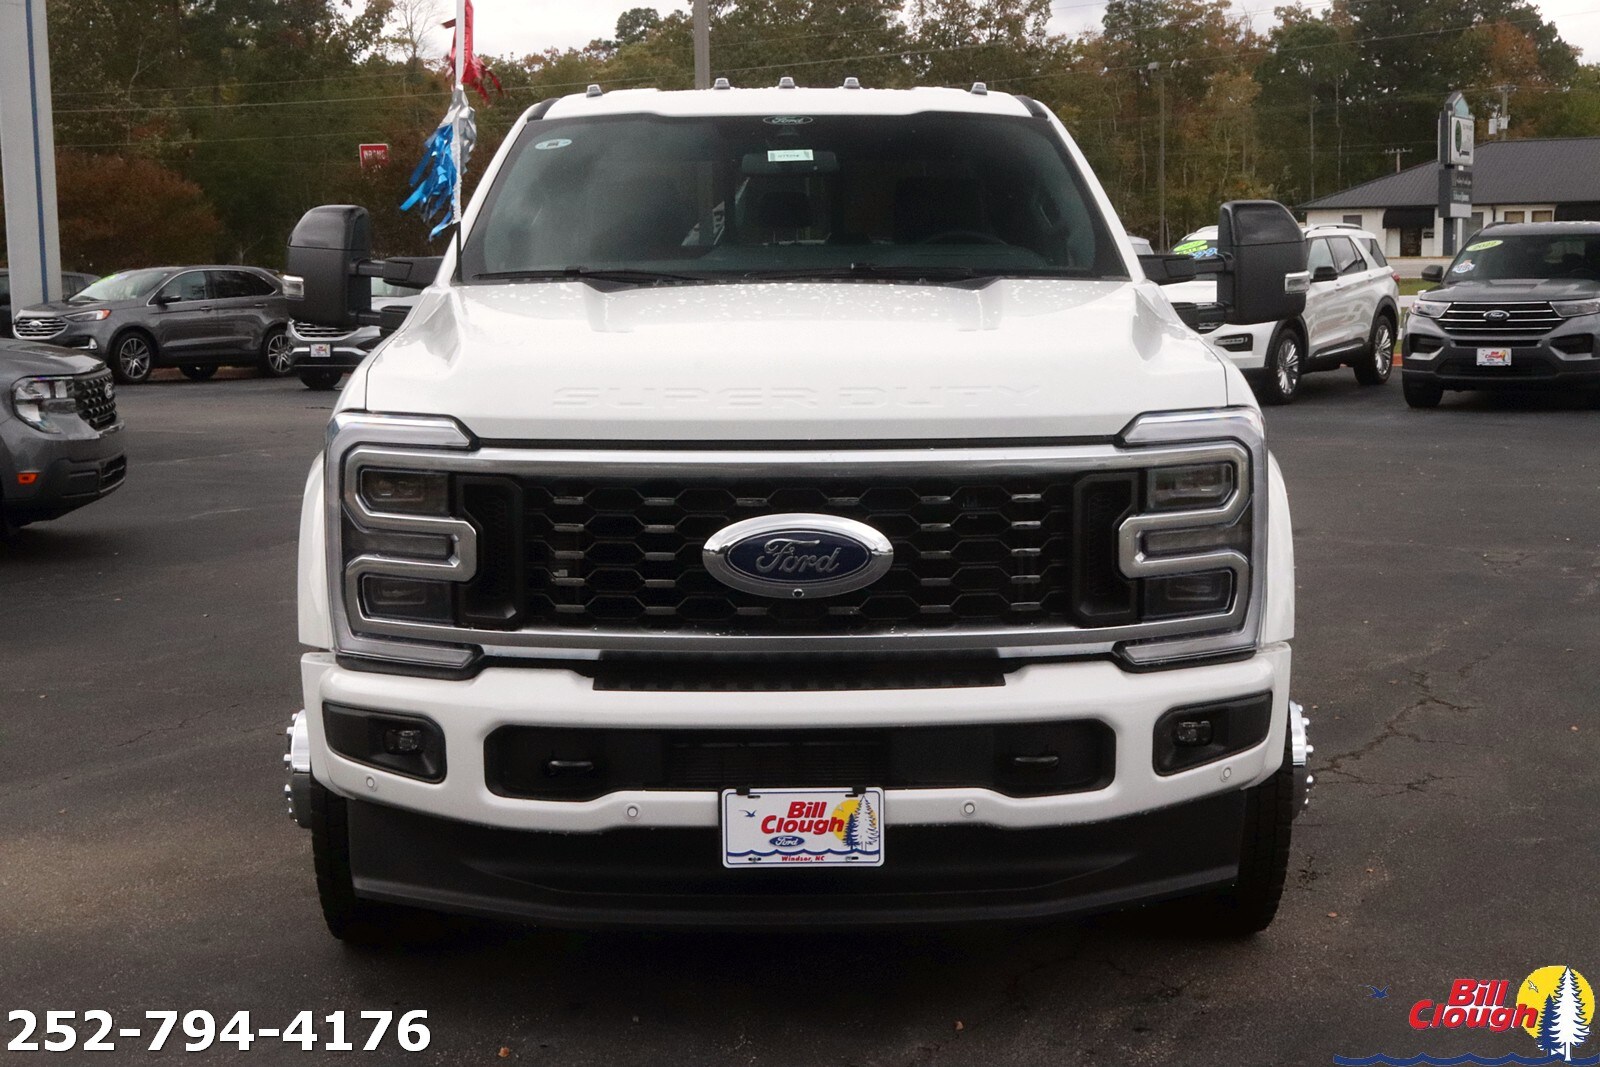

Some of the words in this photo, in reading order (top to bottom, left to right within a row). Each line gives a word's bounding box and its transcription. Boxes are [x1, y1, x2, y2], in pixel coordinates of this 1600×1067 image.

[552, 386, 819, 410] SUPER
[838, 384, 1041, 409] DUTY
[755, 537, 843, 574] Ford
[787, 801, 827, 818] Bill
[761, 815, 845, 835] Clough
[774, 836, 800, 847] Ford
